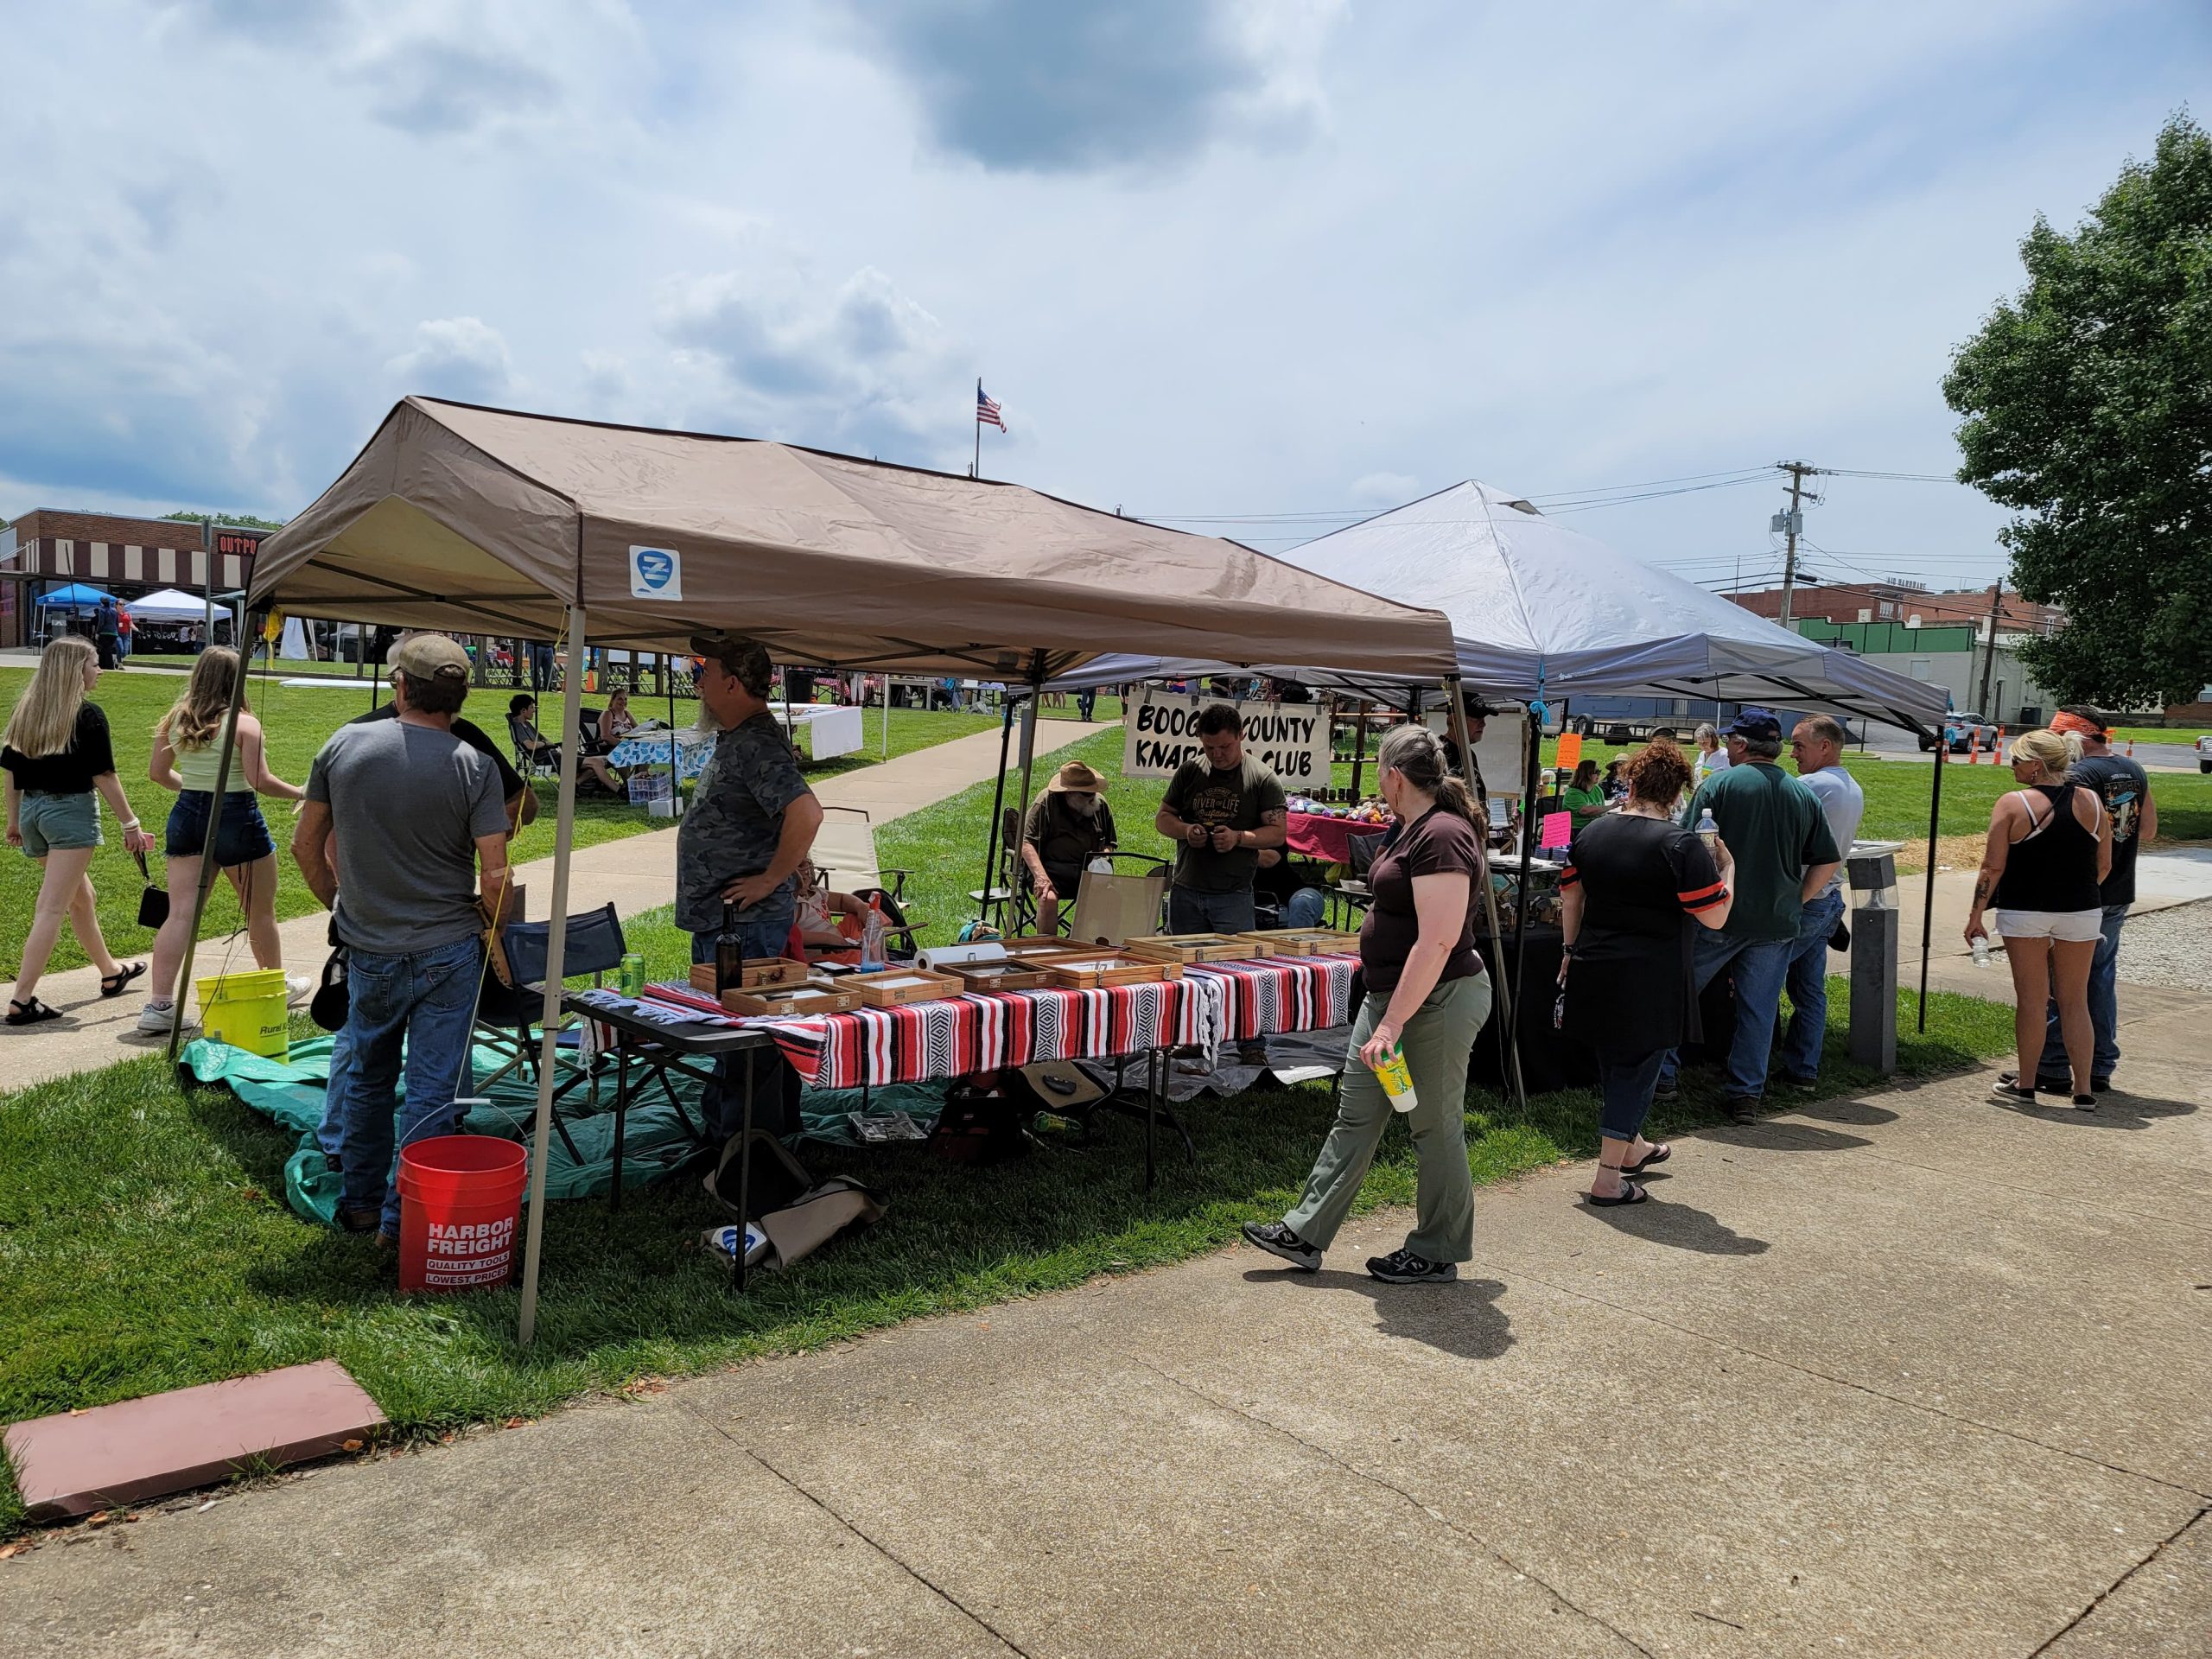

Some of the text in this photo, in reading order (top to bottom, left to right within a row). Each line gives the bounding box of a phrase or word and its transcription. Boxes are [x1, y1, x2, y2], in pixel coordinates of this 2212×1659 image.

[220, 536, 257, 554] OUTPO
[1137, 704, 1315, 743] BOOG COUNTY
[1192, 798, 1216, 810] RIVER
[1222, 799, 1240, 813] LIFE
[260, 1023, 282, 1034] Rural
[429, 1217, 514, 1239] HARBOR
[428, 1230, 512, 1255] FREIGHT
[429, 1252, 508, 1270] QUALITY TOOLS
[427, 1267, 507, 1284] LOWEST PRICES
